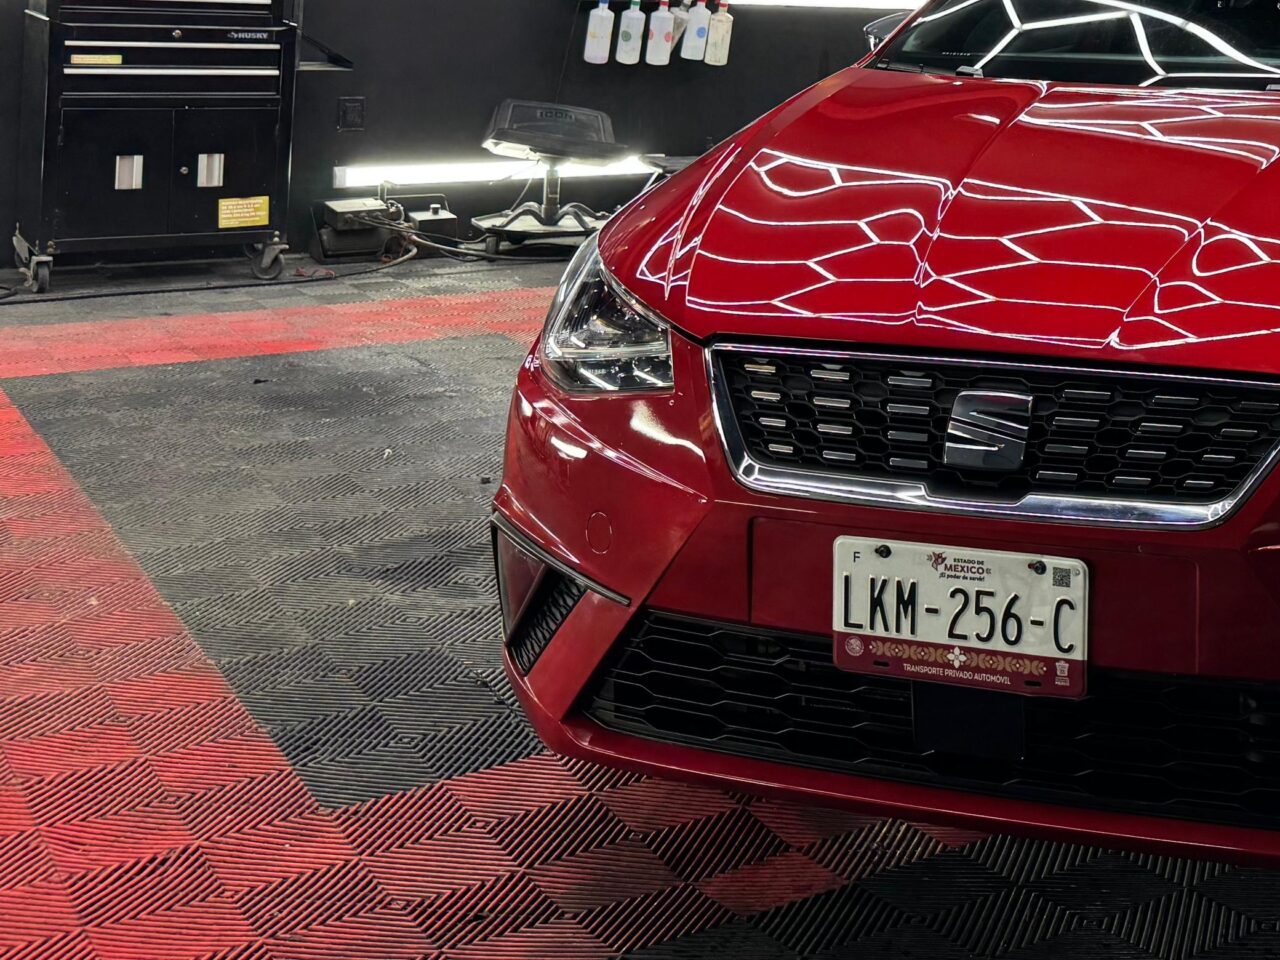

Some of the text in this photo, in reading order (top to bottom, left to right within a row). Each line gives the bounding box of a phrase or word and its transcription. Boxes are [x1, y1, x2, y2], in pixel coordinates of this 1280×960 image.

[853, 551, 861, 563] F
[843, 573, 1076, 654] LKM-256-C
[903, 663, 1011, 685] TRANSPORTE PRIVADO AUTOMÓVIL
